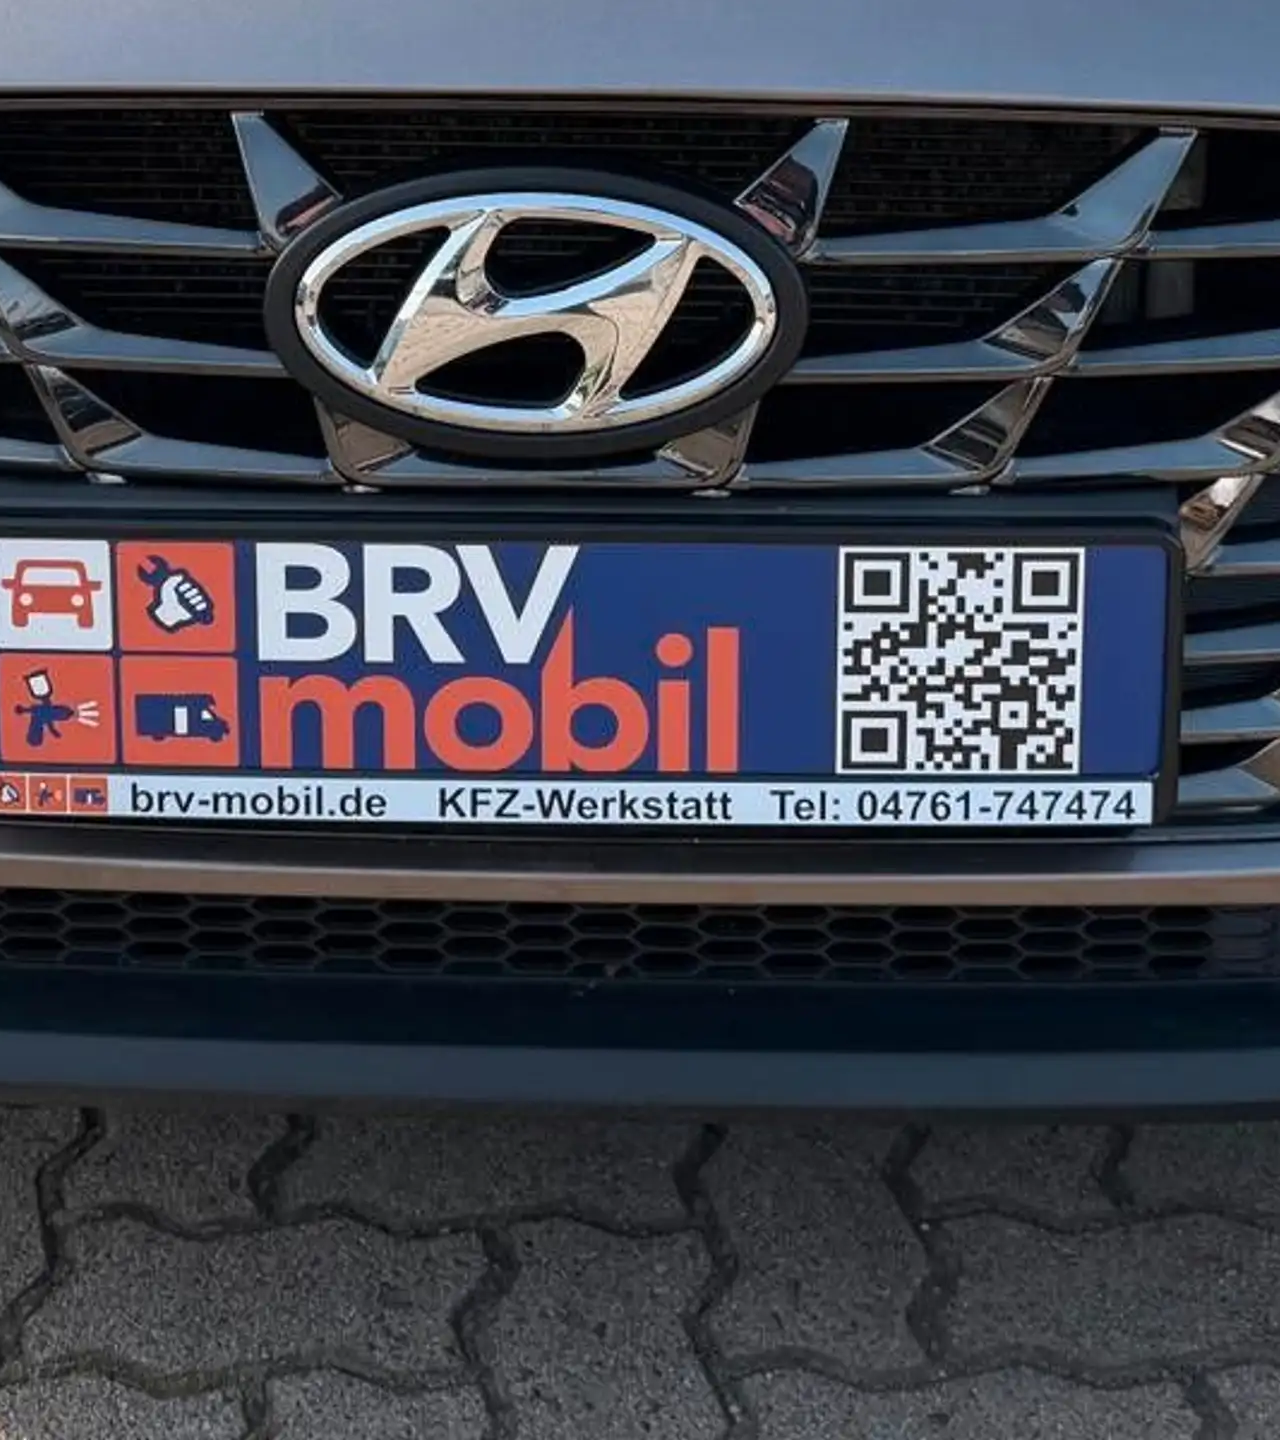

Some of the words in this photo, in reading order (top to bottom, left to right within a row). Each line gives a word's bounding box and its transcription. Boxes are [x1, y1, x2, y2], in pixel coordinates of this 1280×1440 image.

[255, 541, 580, 664] BRV
[258, 605, 740, 774] mobil
[130, 782, 388, 819] brv-mobil.de
[437, 787, 734, 822] KFZ-Werkstatt
[770, 789, 841, 821] Tel:
[856, 789, 1137, 822] 04761-747474
